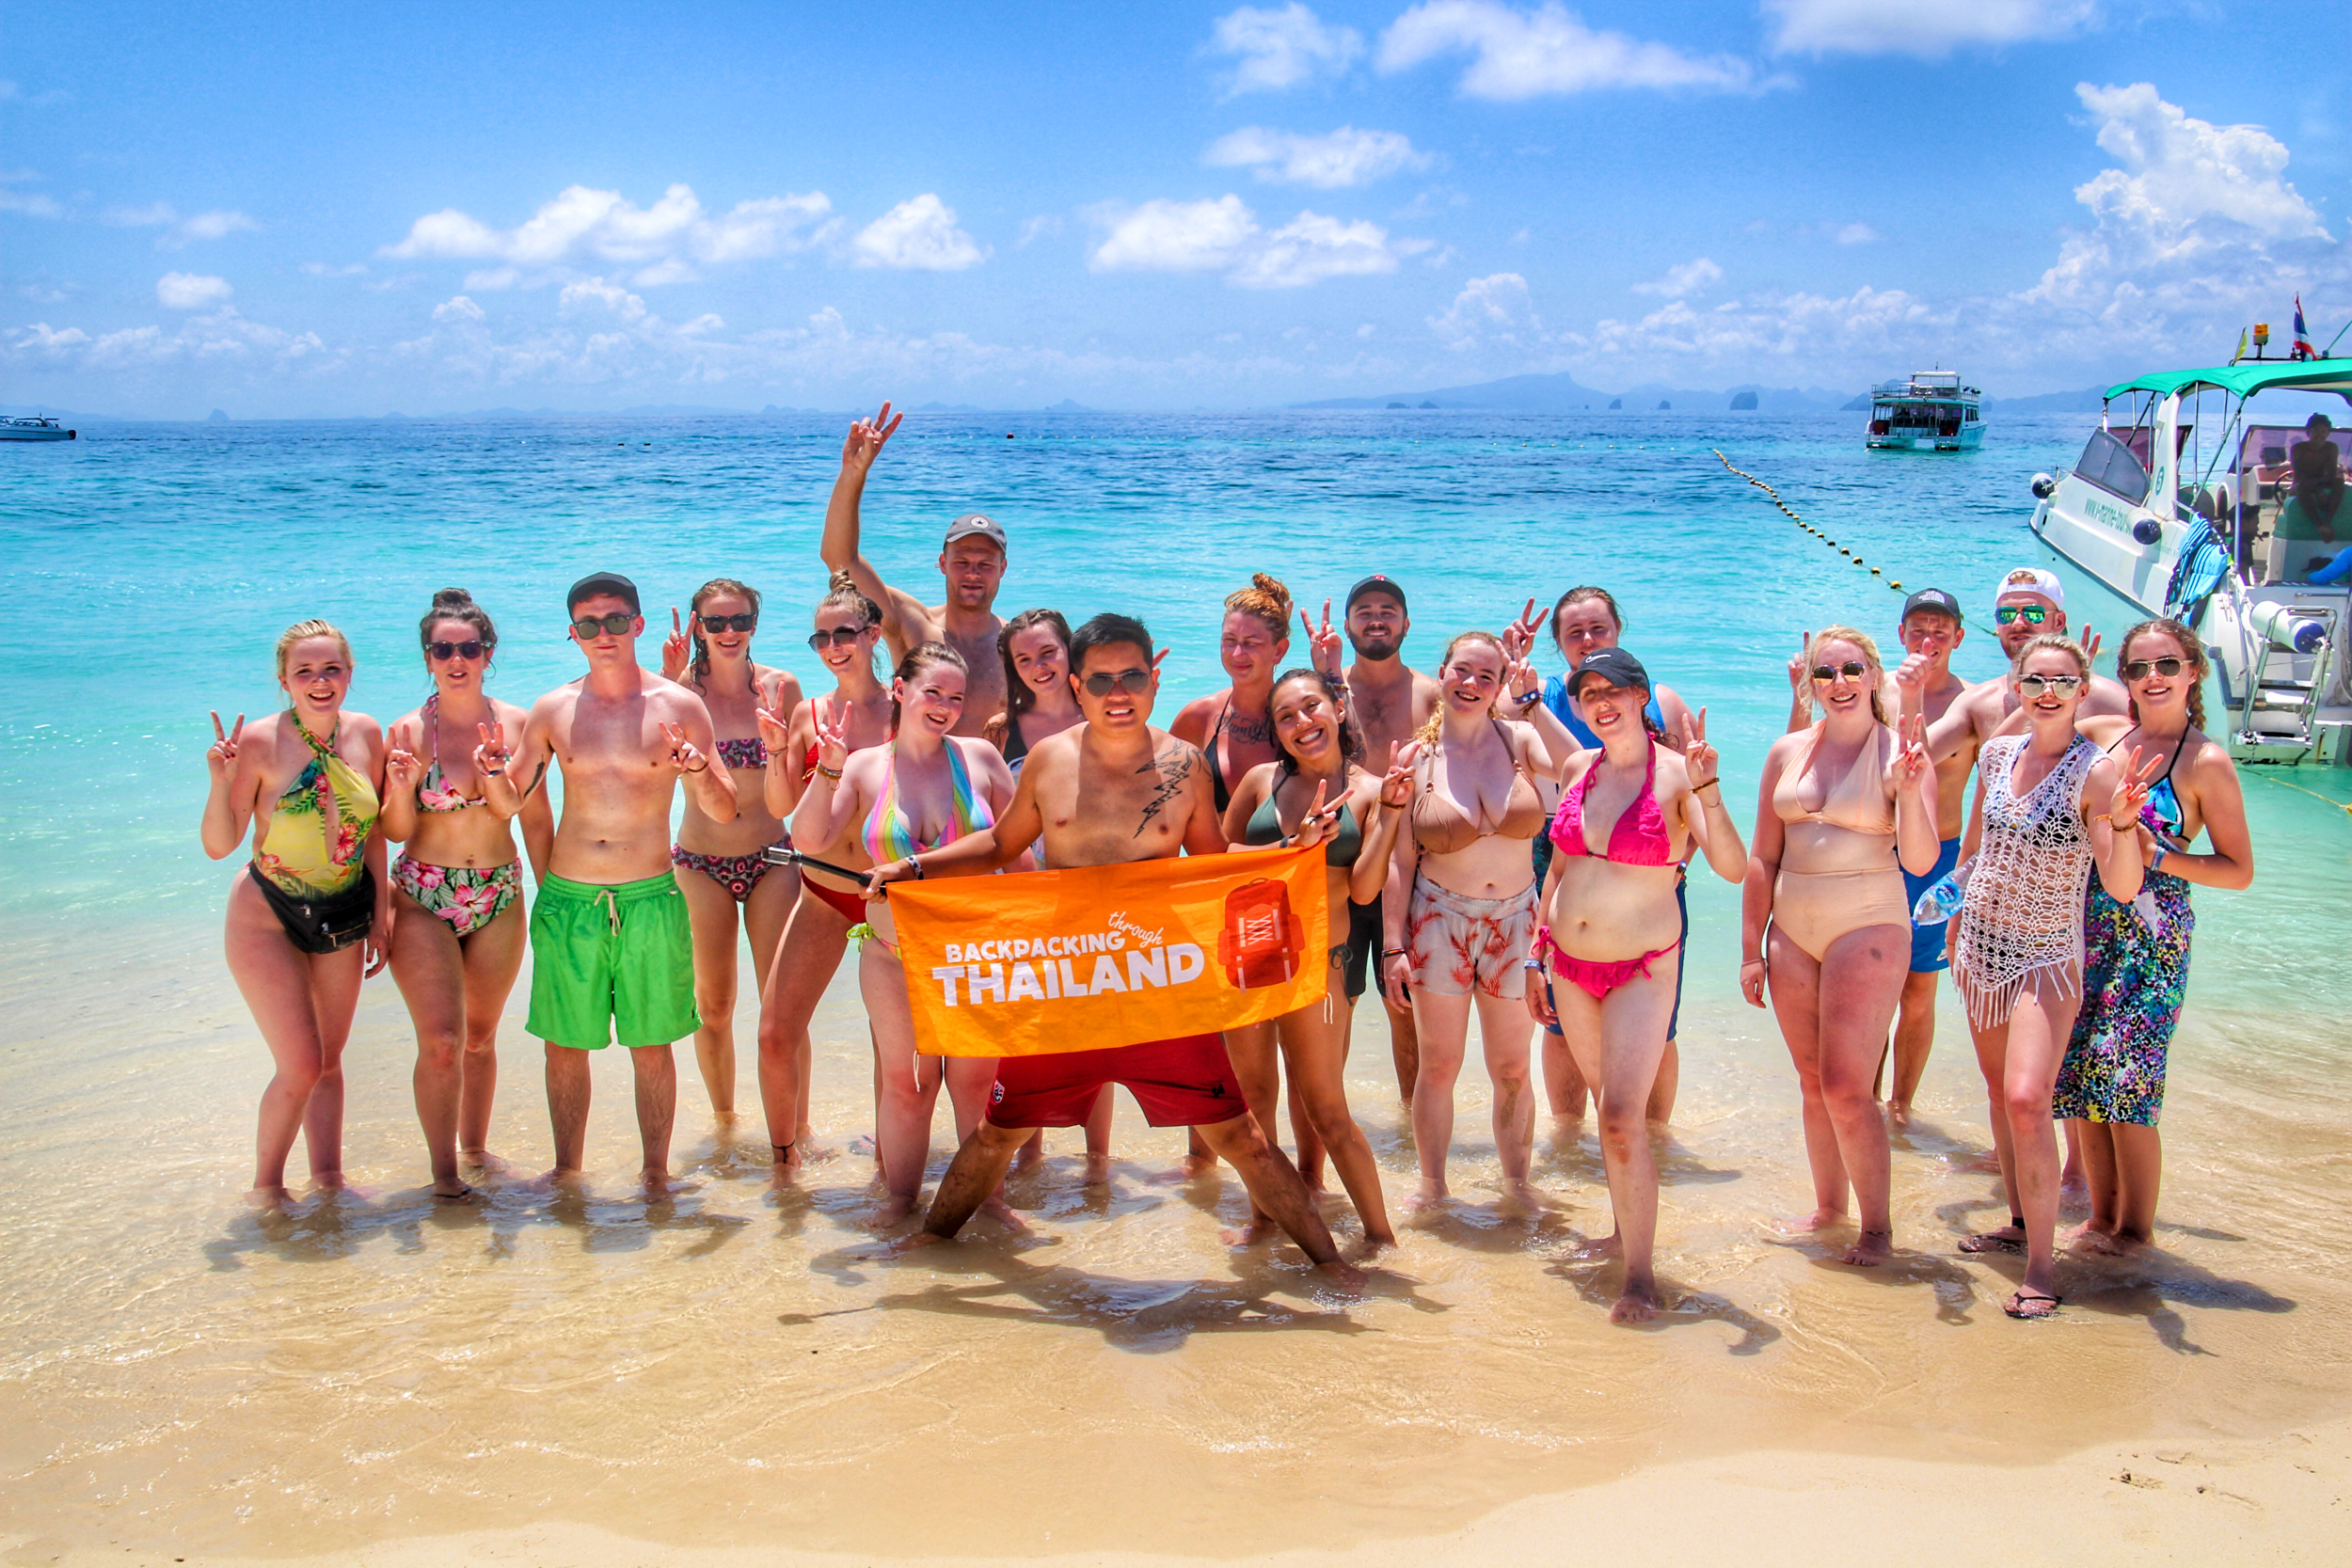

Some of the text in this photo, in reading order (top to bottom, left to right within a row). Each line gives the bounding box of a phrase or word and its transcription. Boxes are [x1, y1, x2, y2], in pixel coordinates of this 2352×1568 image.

[945, 911, 1164, 963] BACKPACKING through
[931, 942, 1205, 1006] THAILAND
